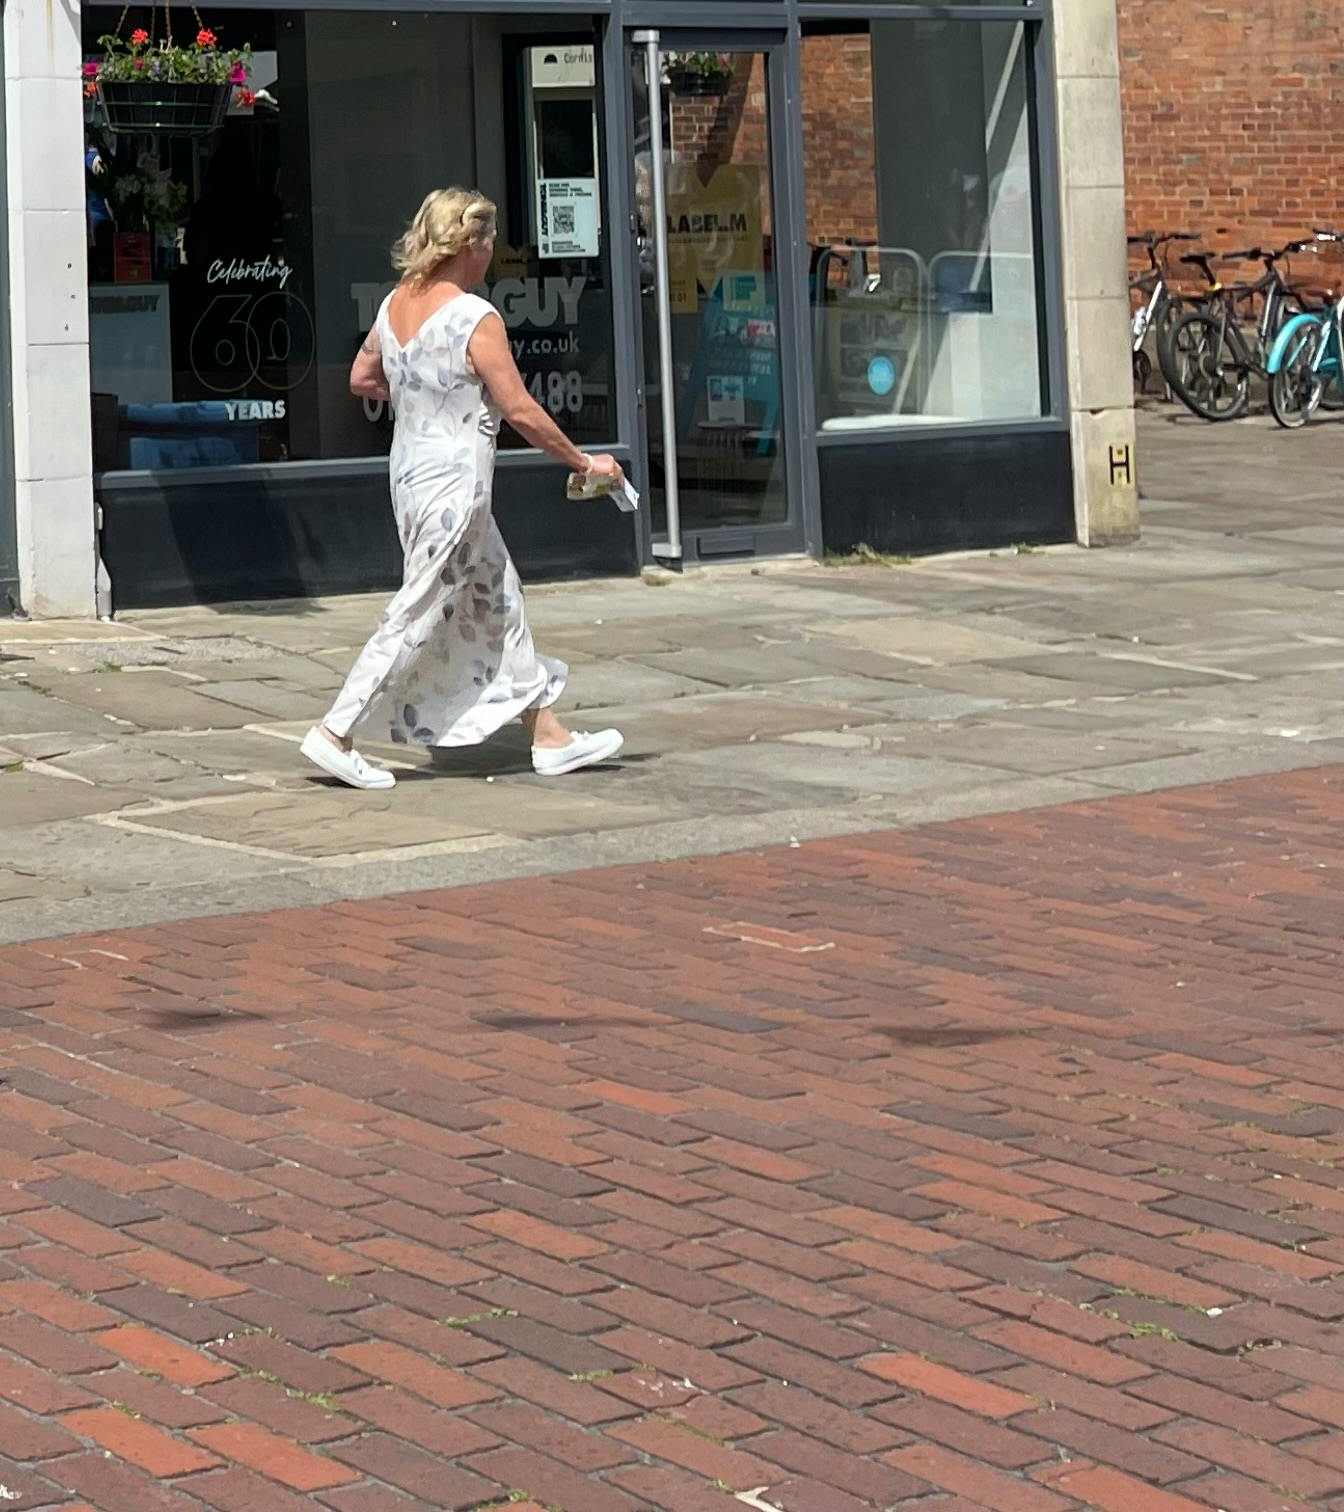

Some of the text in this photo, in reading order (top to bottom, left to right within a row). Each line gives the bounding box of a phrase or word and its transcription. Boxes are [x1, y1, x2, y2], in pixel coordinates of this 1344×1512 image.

[206, 254, 293, 289] Celebrating
[189, 291, 316, 393] 60
[223, 400, 287, 421] YEARS
[1108, 444, 1130, 485] H
